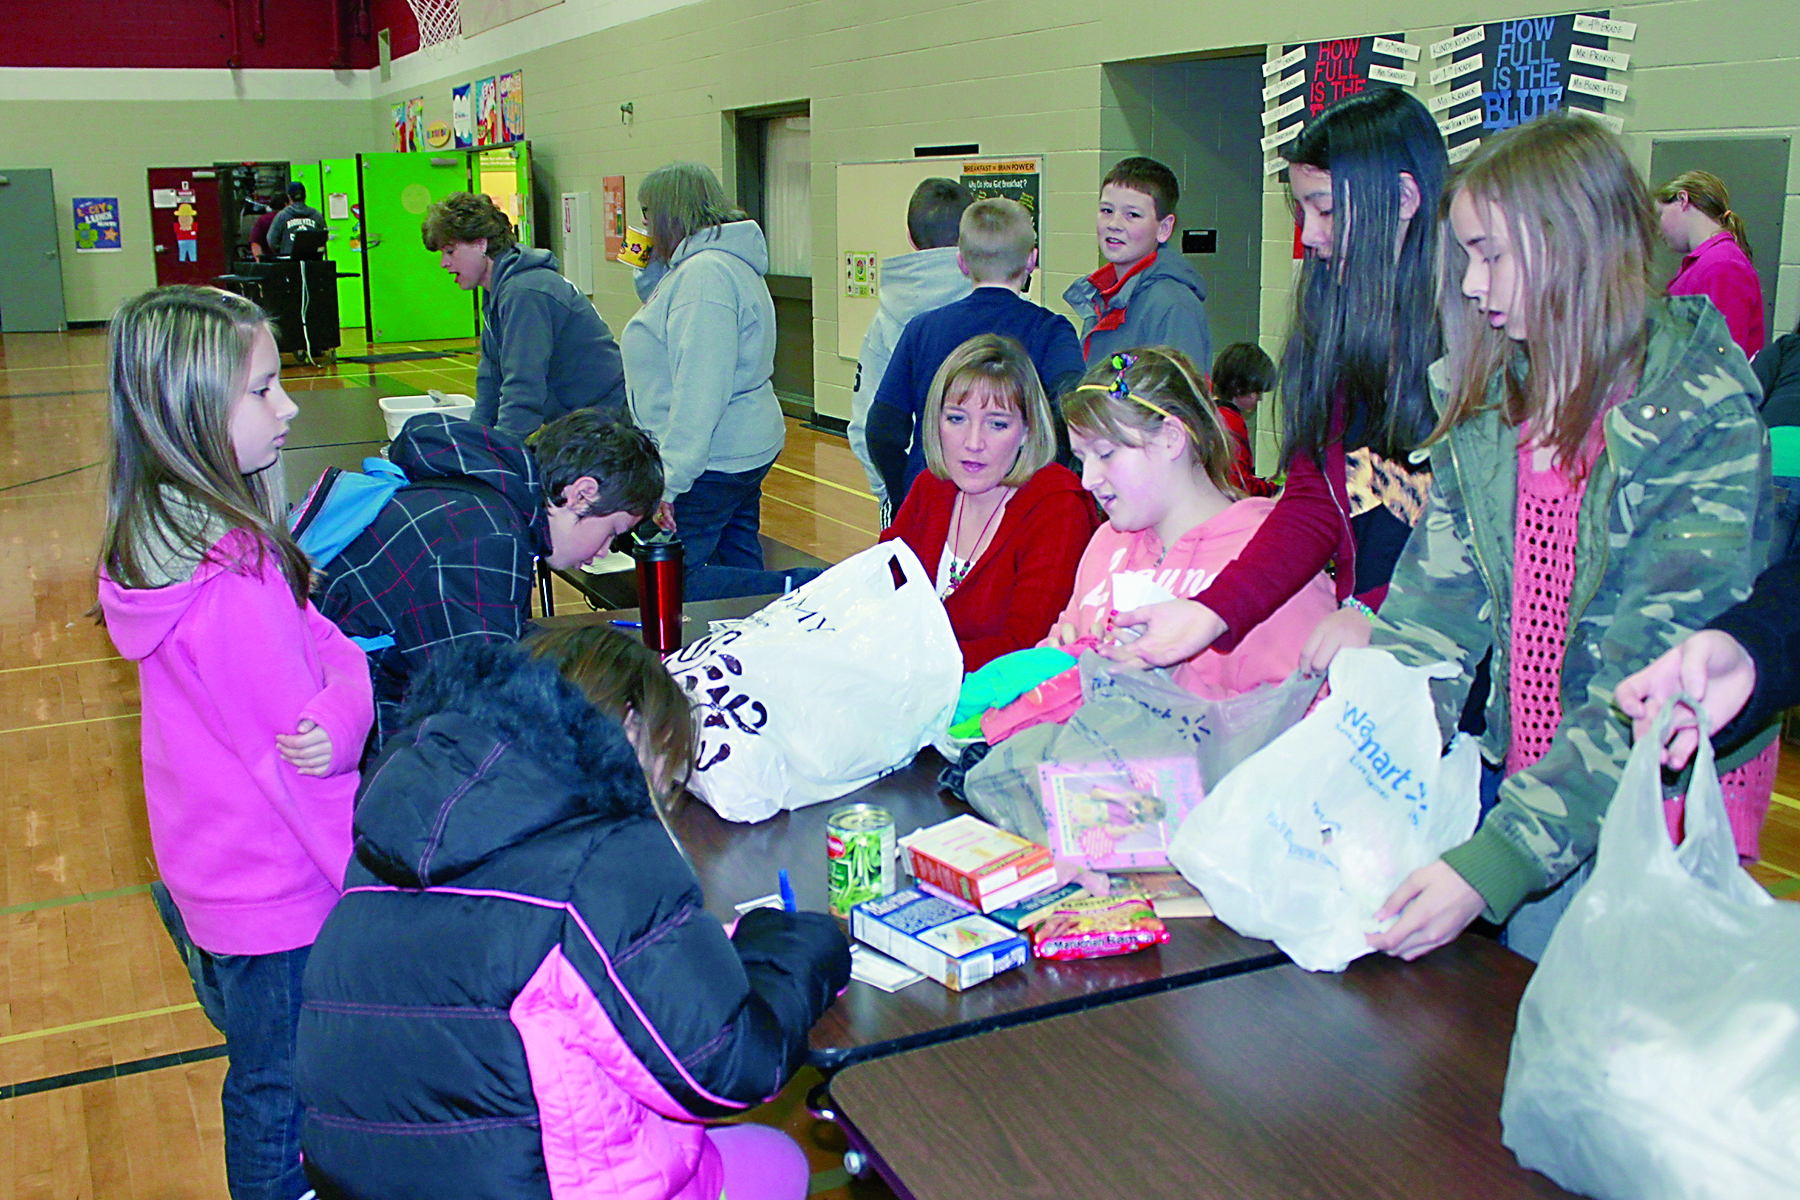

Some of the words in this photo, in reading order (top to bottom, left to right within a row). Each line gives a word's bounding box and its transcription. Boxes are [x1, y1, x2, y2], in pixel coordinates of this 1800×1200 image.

[1432, 31, 1483, 55] KINDERGARTEN
[1501, 17, 1556, 44] HOW
[1319, 38, 1361, 61] HOW
[1496, 40, 1555, 68] FULL
[1314, 58, 1360, 81] FULL
[1492, 66, 1511, 90] IS
[1515, 62, 1561, 89] THE
[1310, 81, 1326, 103] IS
[1331, 78, 1367, 101] THE
[963, 164, 992, 172] BREAKFAST
[1011, 162, 1035, 170] POWER
[1343, 700, 1412, 791] Wamart
